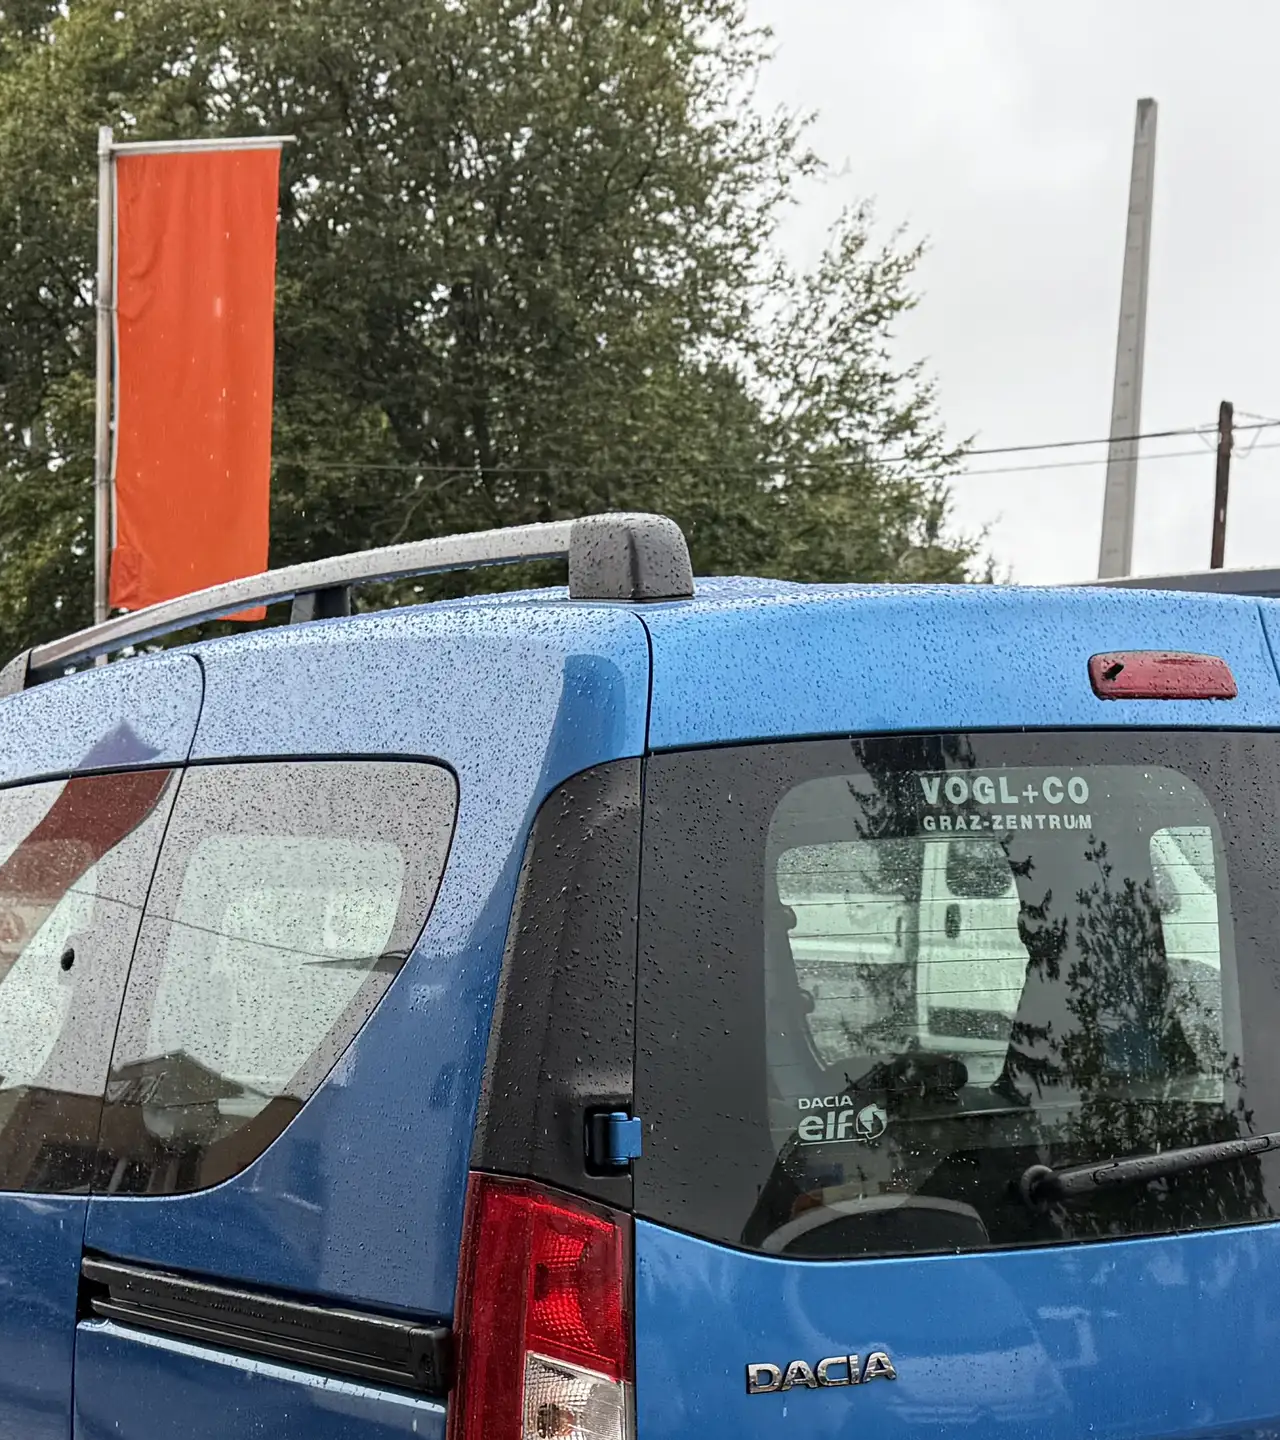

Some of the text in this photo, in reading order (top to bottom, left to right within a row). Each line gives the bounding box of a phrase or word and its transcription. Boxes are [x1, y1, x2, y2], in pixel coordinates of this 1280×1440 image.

[920, 776, 1089, 804] VOGL+CO
[923, 814, 1092, 831] GRAZ-ZENTRUM
[798, 1095, 854, 1110] DACIA
[798, 1109, 854, 1141] elf
[746, 1351, 897, 1394] DACIA
